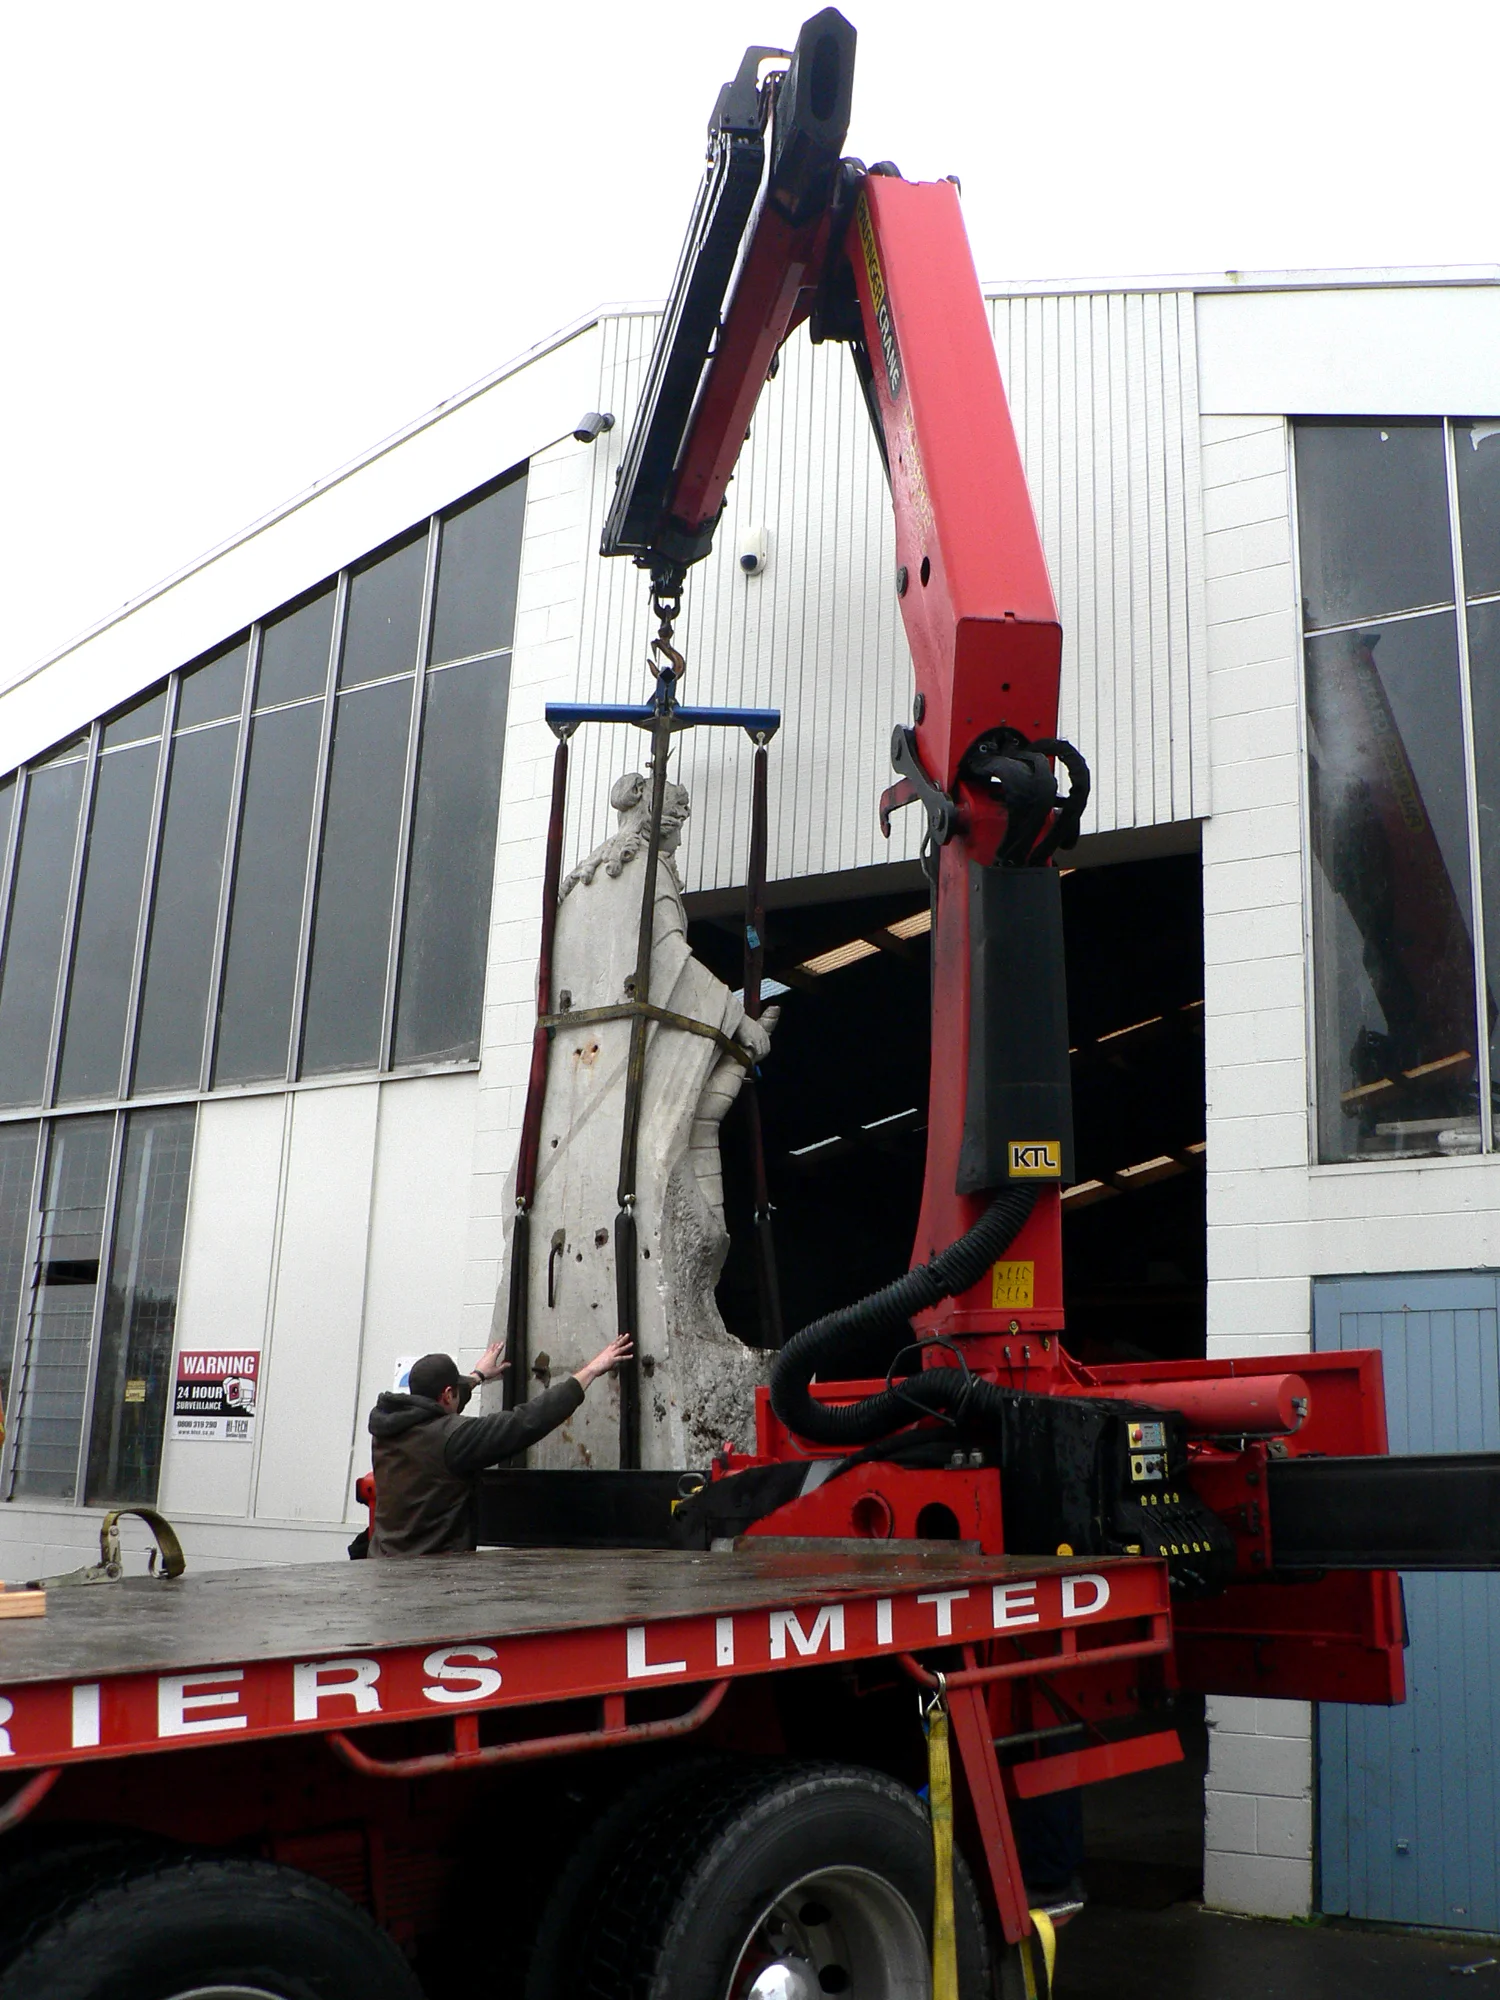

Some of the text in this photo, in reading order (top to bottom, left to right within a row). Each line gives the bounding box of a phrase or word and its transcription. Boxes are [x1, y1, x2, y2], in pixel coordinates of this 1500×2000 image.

[878, 304, 900, 391] CRANE
[1013, 1146, 1057, 1168] KTL
[183, 1356, 255, 1375] WARNING
[177, 1387, 223, 1399] 24 HOUR
[176, 1401, 222, 1411] SURVEILLANCE
[226, 1420, 249, 1433] HI-TECH
[0, 1573, 1111, 1757] IERS LIMITED
